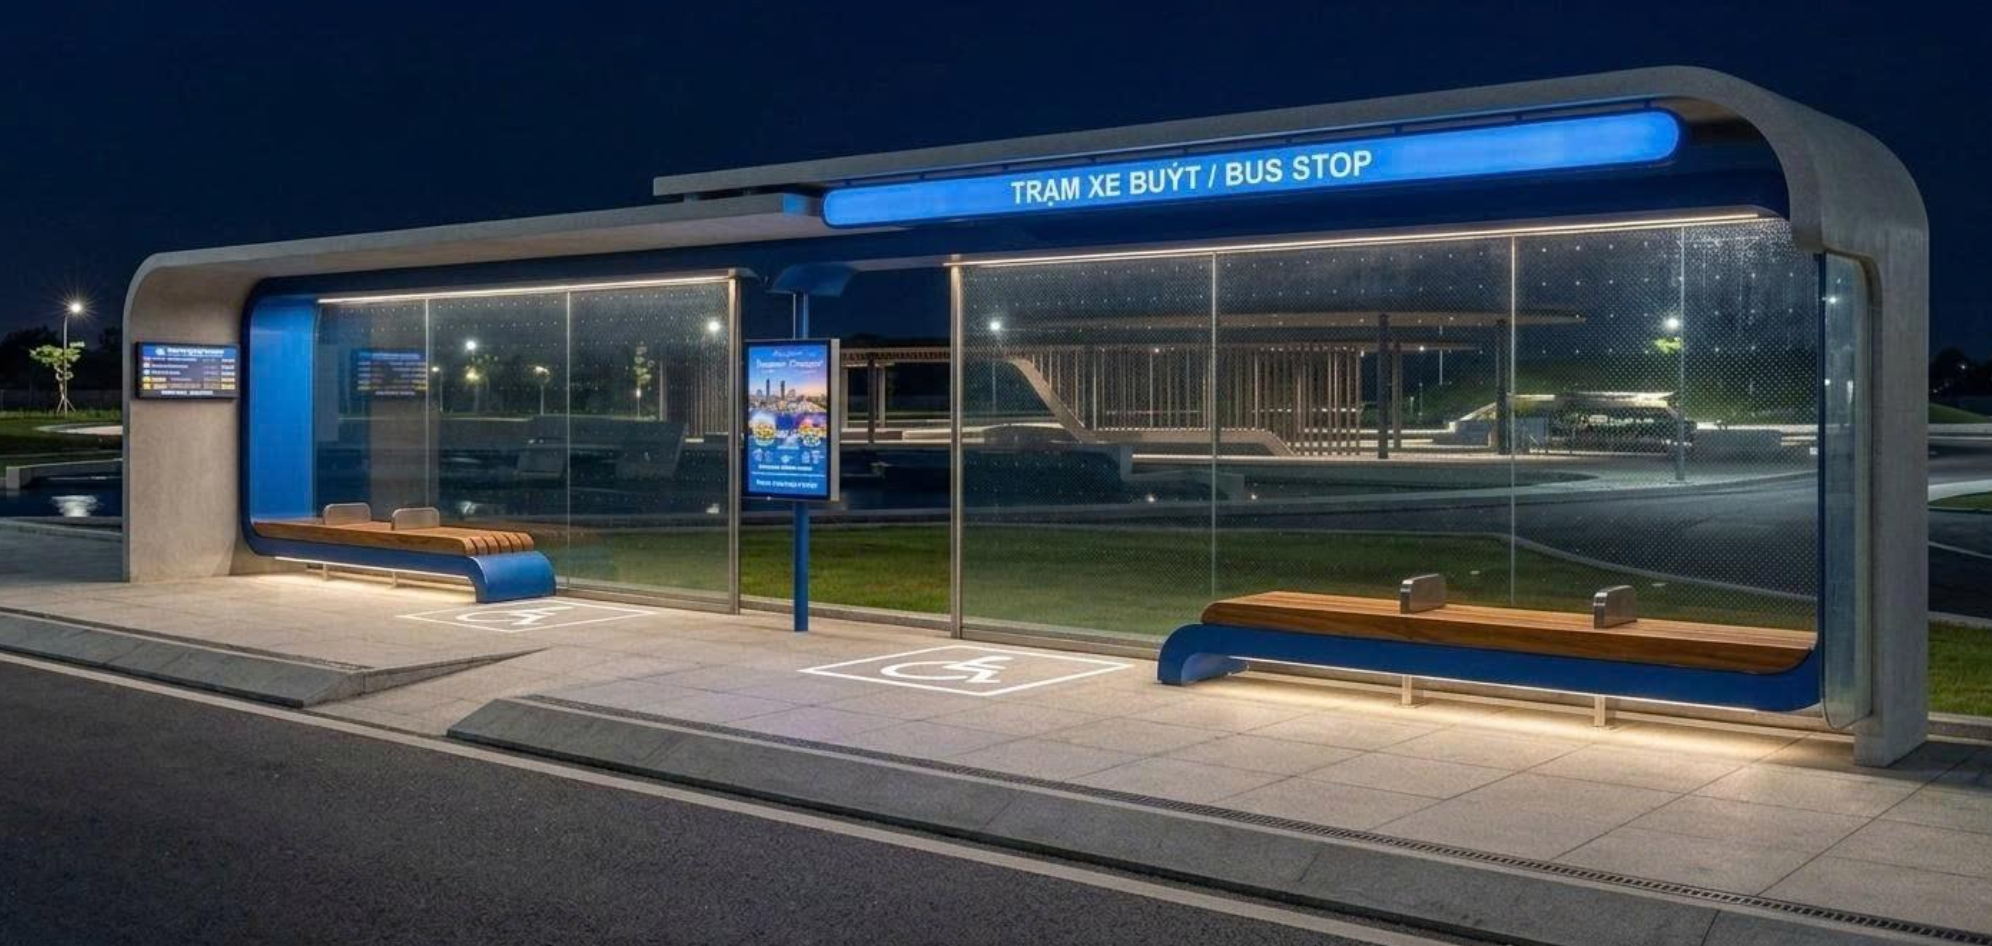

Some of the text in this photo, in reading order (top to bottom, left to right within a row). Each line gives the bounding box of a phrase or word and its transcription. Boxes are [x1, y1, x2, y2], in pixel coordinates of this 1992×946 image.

[1011, 150, 1372, 206] TRẠM XE BUÝT / BUS STOP
